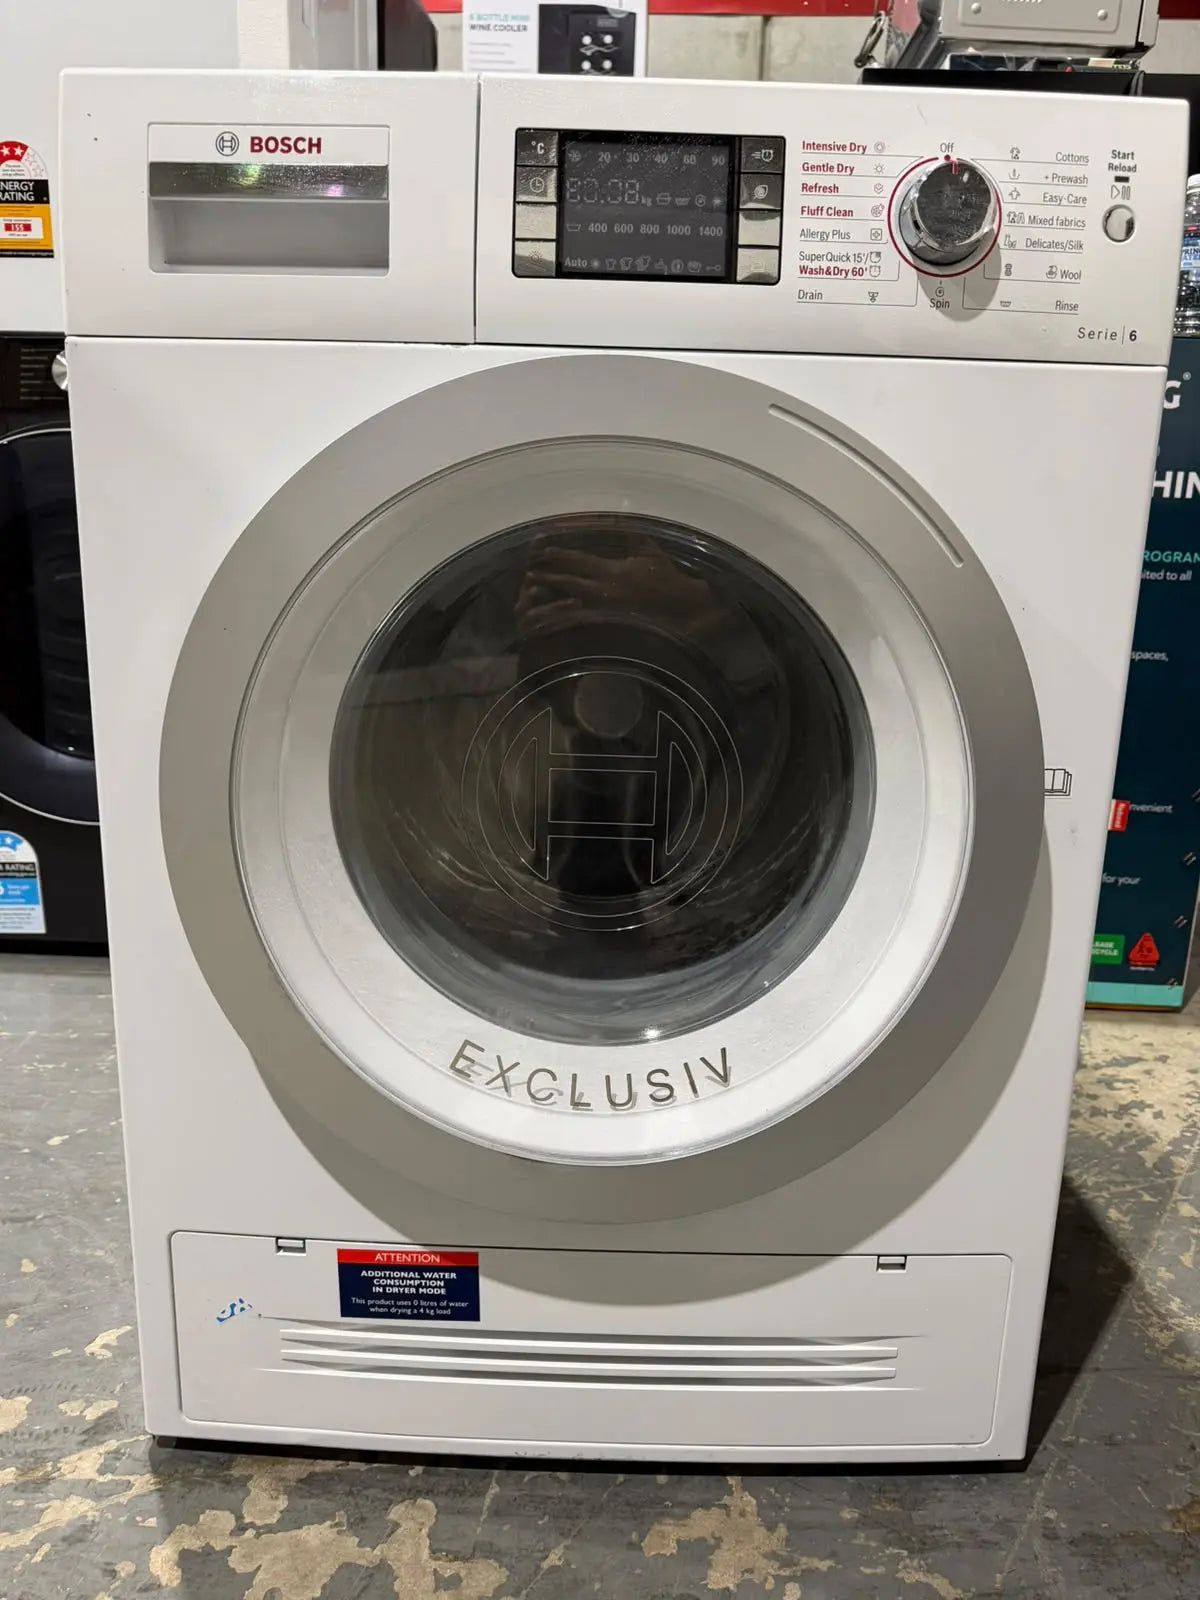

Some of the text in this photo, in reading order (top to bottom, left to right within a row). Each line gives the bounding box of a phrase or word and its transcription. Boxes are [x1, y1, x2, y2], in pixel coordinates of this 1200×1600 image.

[470, 23, 528, 33] WINE COOLER
[249, 135, 322, 155] BOSCH
[802, 141, 867, 155] Intensive Dry
[939, 142, 955, 153] Off
[598, 152, 725, 166] 20 30 40 60 90
[1055, 151, 1089, 163] Cottons
[1111, 149, 1135, 160] Start
[802, 162, 855, 176] Gentle Dry
[1107, 162, 1137, 173] Reload
[1051, 172, 1088, 185] Prewash
[0, 181, 35, 191] NERGY
[801, 182, 839, 193] Refresh
[800, 205, 854, 217] Fluff Clean
[1028, 215, 1086, 228] Mixed fabrics
[588, 222, 724, 237] 400 600 800 1000 1400
[799, 228, 851, 241] Allergy Plus
[1025, 237, 1084, 251] Delicates/Silk
[564, 256, 588, 267] Auto
[799, 264, 868, 279] Wash&Dry 60'
[1060, 269, 1082, 280] Wool
[797, 289, 823, 300] Drain
[929, 297, 950, 310] Spin
[1055, 299, 1079, 312] Rinse
[1077, 326, 1138, 342] Serie 6
[1166, 571, 1178, 581] to
[1179, 569, 1193, 581] all
[1117, 876, 1141, 887] your
[449, 1038, 731, 1108] EXCLUSIV
[374, 1252, 441, 1264] ATTENTION
[360, 1270, 457, 1280] ADDITIONAL WATER
[373, 1278, 445, 1287] CONSUMPTION
[386, 1286, 417, 1294] DRYER
[419, 1287, 446, 1295] MODE
[351, 1297, 366, 1305] This
[367, 1299, 395, 1307] product
[420, 1299, 438, 1307] litres
[389, 1307, 412, 1316] drying
[419, 1307, 425, 1315] 4
[425, 1308, 434, 1317] kg
